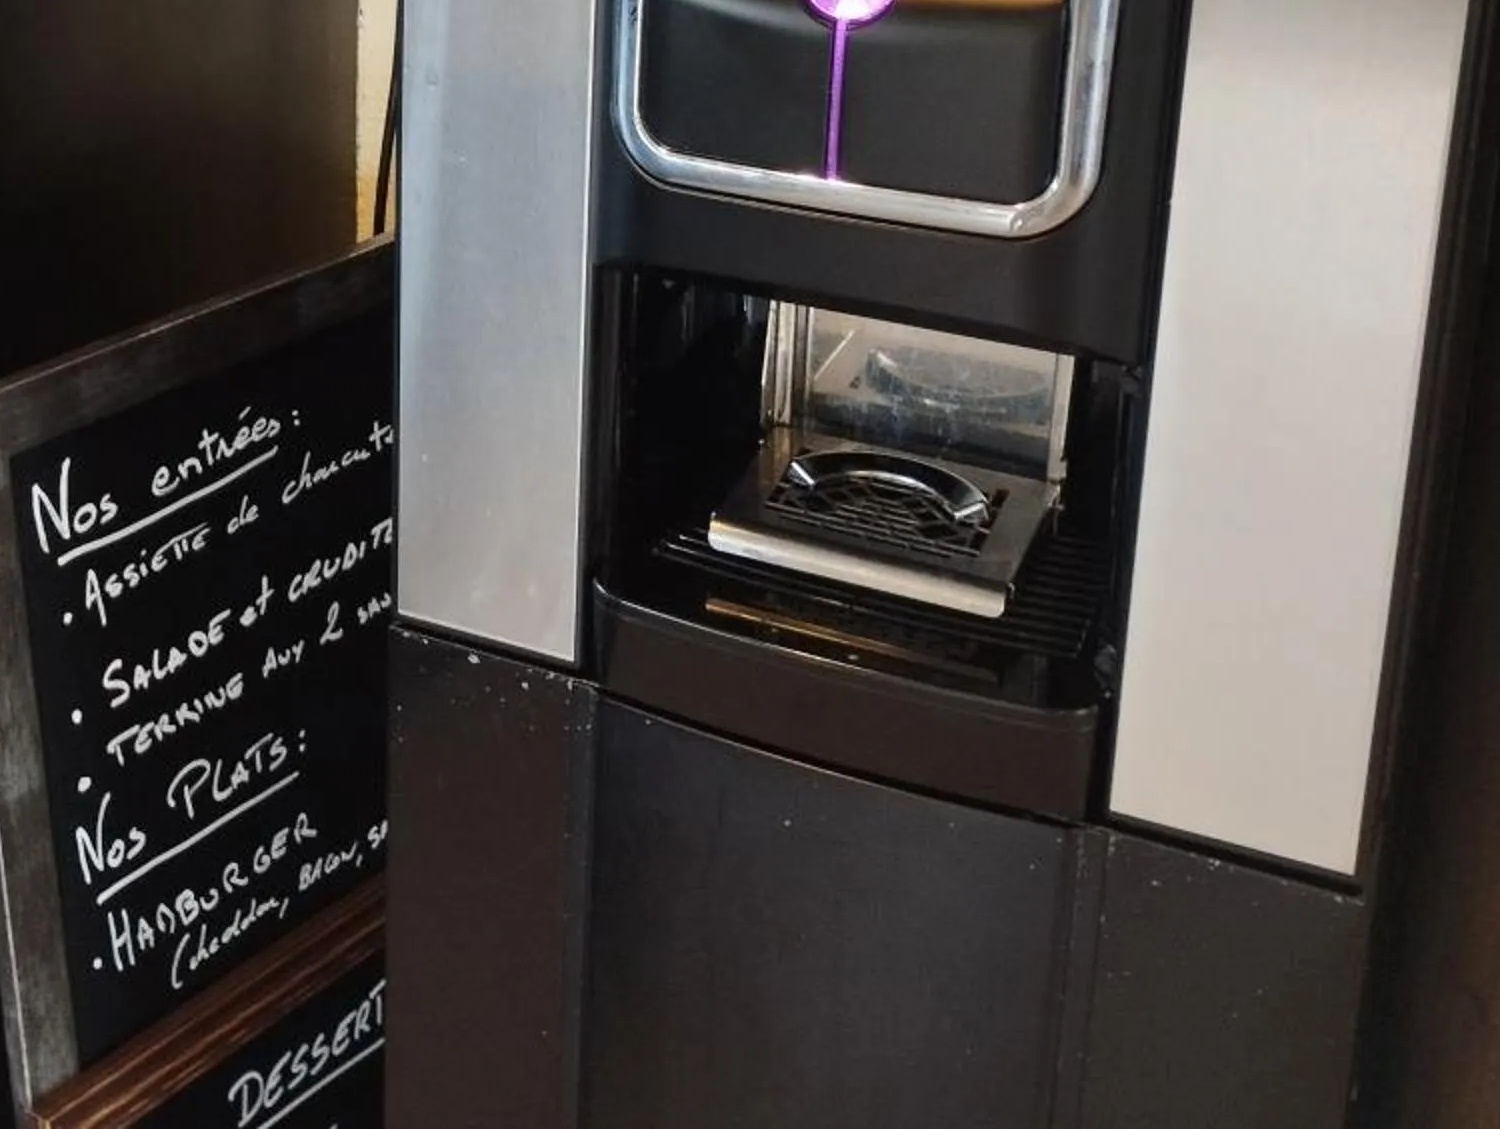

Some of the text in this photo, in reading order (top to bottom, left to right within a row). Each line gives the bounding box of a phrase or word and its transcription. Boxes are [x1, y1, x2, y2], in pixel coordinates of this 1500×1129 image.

[31, 457, 119, 553] Nos
[227, 496, 259, 534] de
[102, 608, 231, 708] SALADE
[239, 575, 275, 627] et
[106, 672, 244, 766] TERRINE
[319, 601, 343, 645] 2
[75, 791, 146, 885] Nos
[227, 979, 386, 1128] DESSERT
